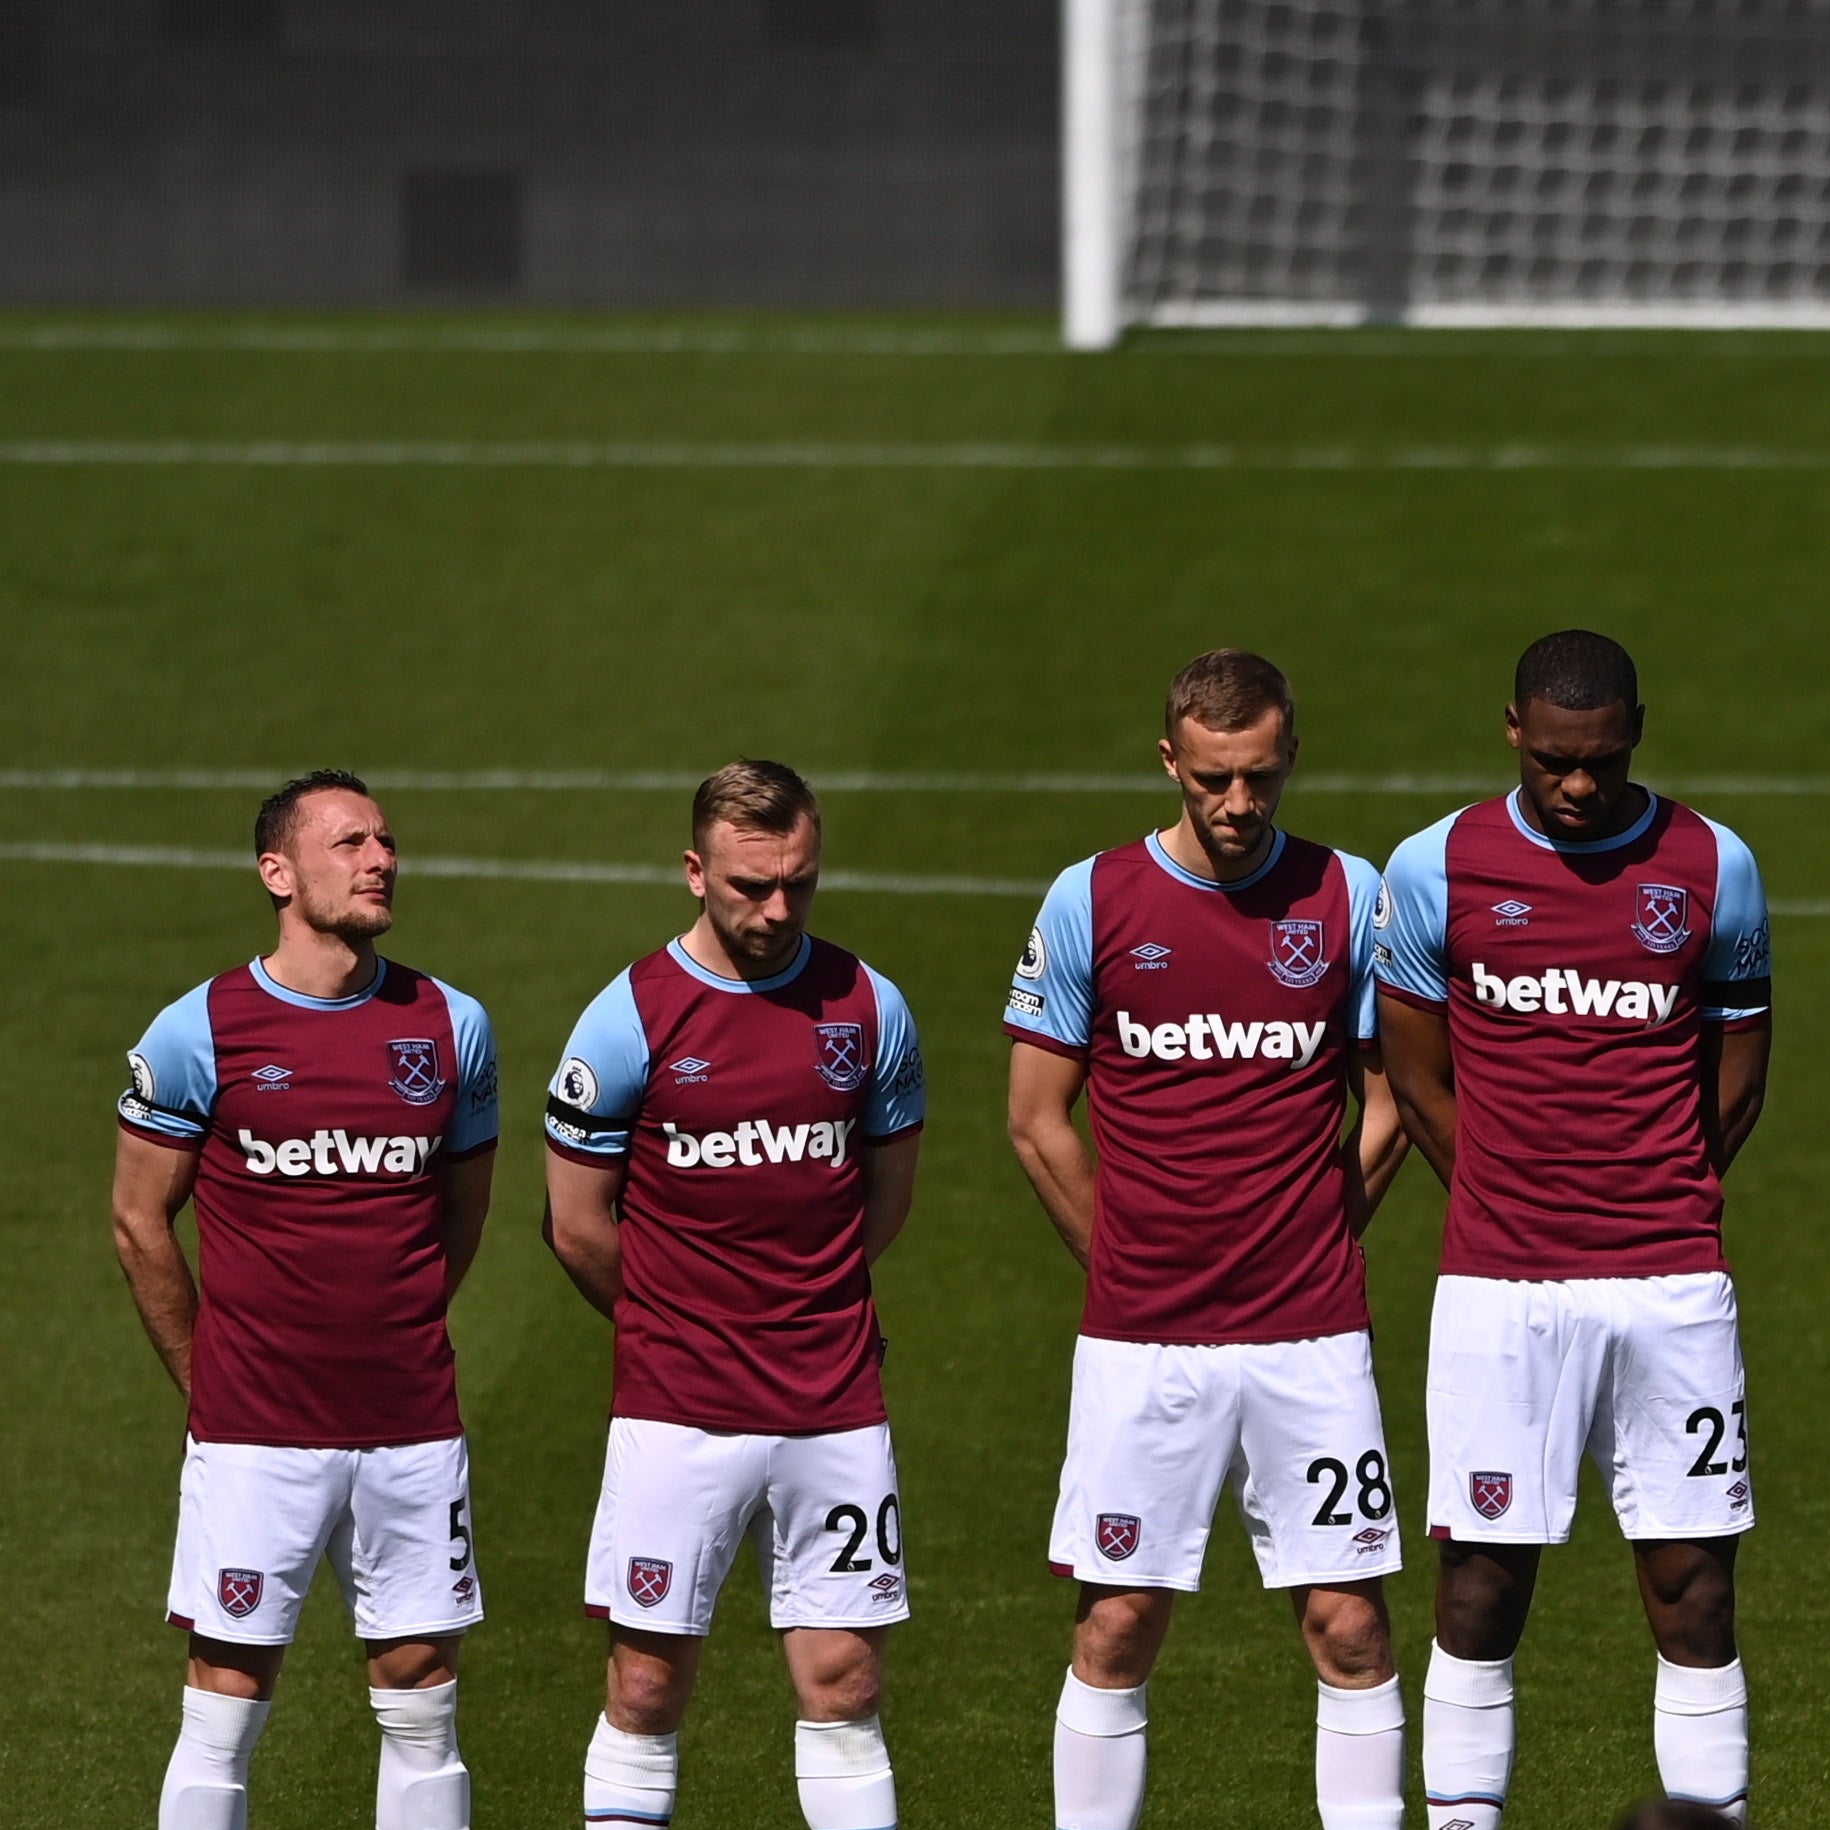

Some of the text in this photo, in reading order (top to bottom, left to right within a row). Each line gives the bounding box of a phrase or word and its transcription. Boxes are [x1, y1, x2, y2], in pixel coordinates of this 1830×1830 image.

[1472, 963, 1679, 1029] betway
[1117, 1011, 1326, 1069] betway
[674, 1073, 708, 1084] umbro
[238, 1129, 442, 1181] betway
[663, 1118, 856, 1168] betway
[1306, 1449, 1391, 1526] 28
[450, 1498, 470, 1571] 5
[825, 1493, 900, 1572] 20
[1357, 1544, 1383, 1554] umbro
